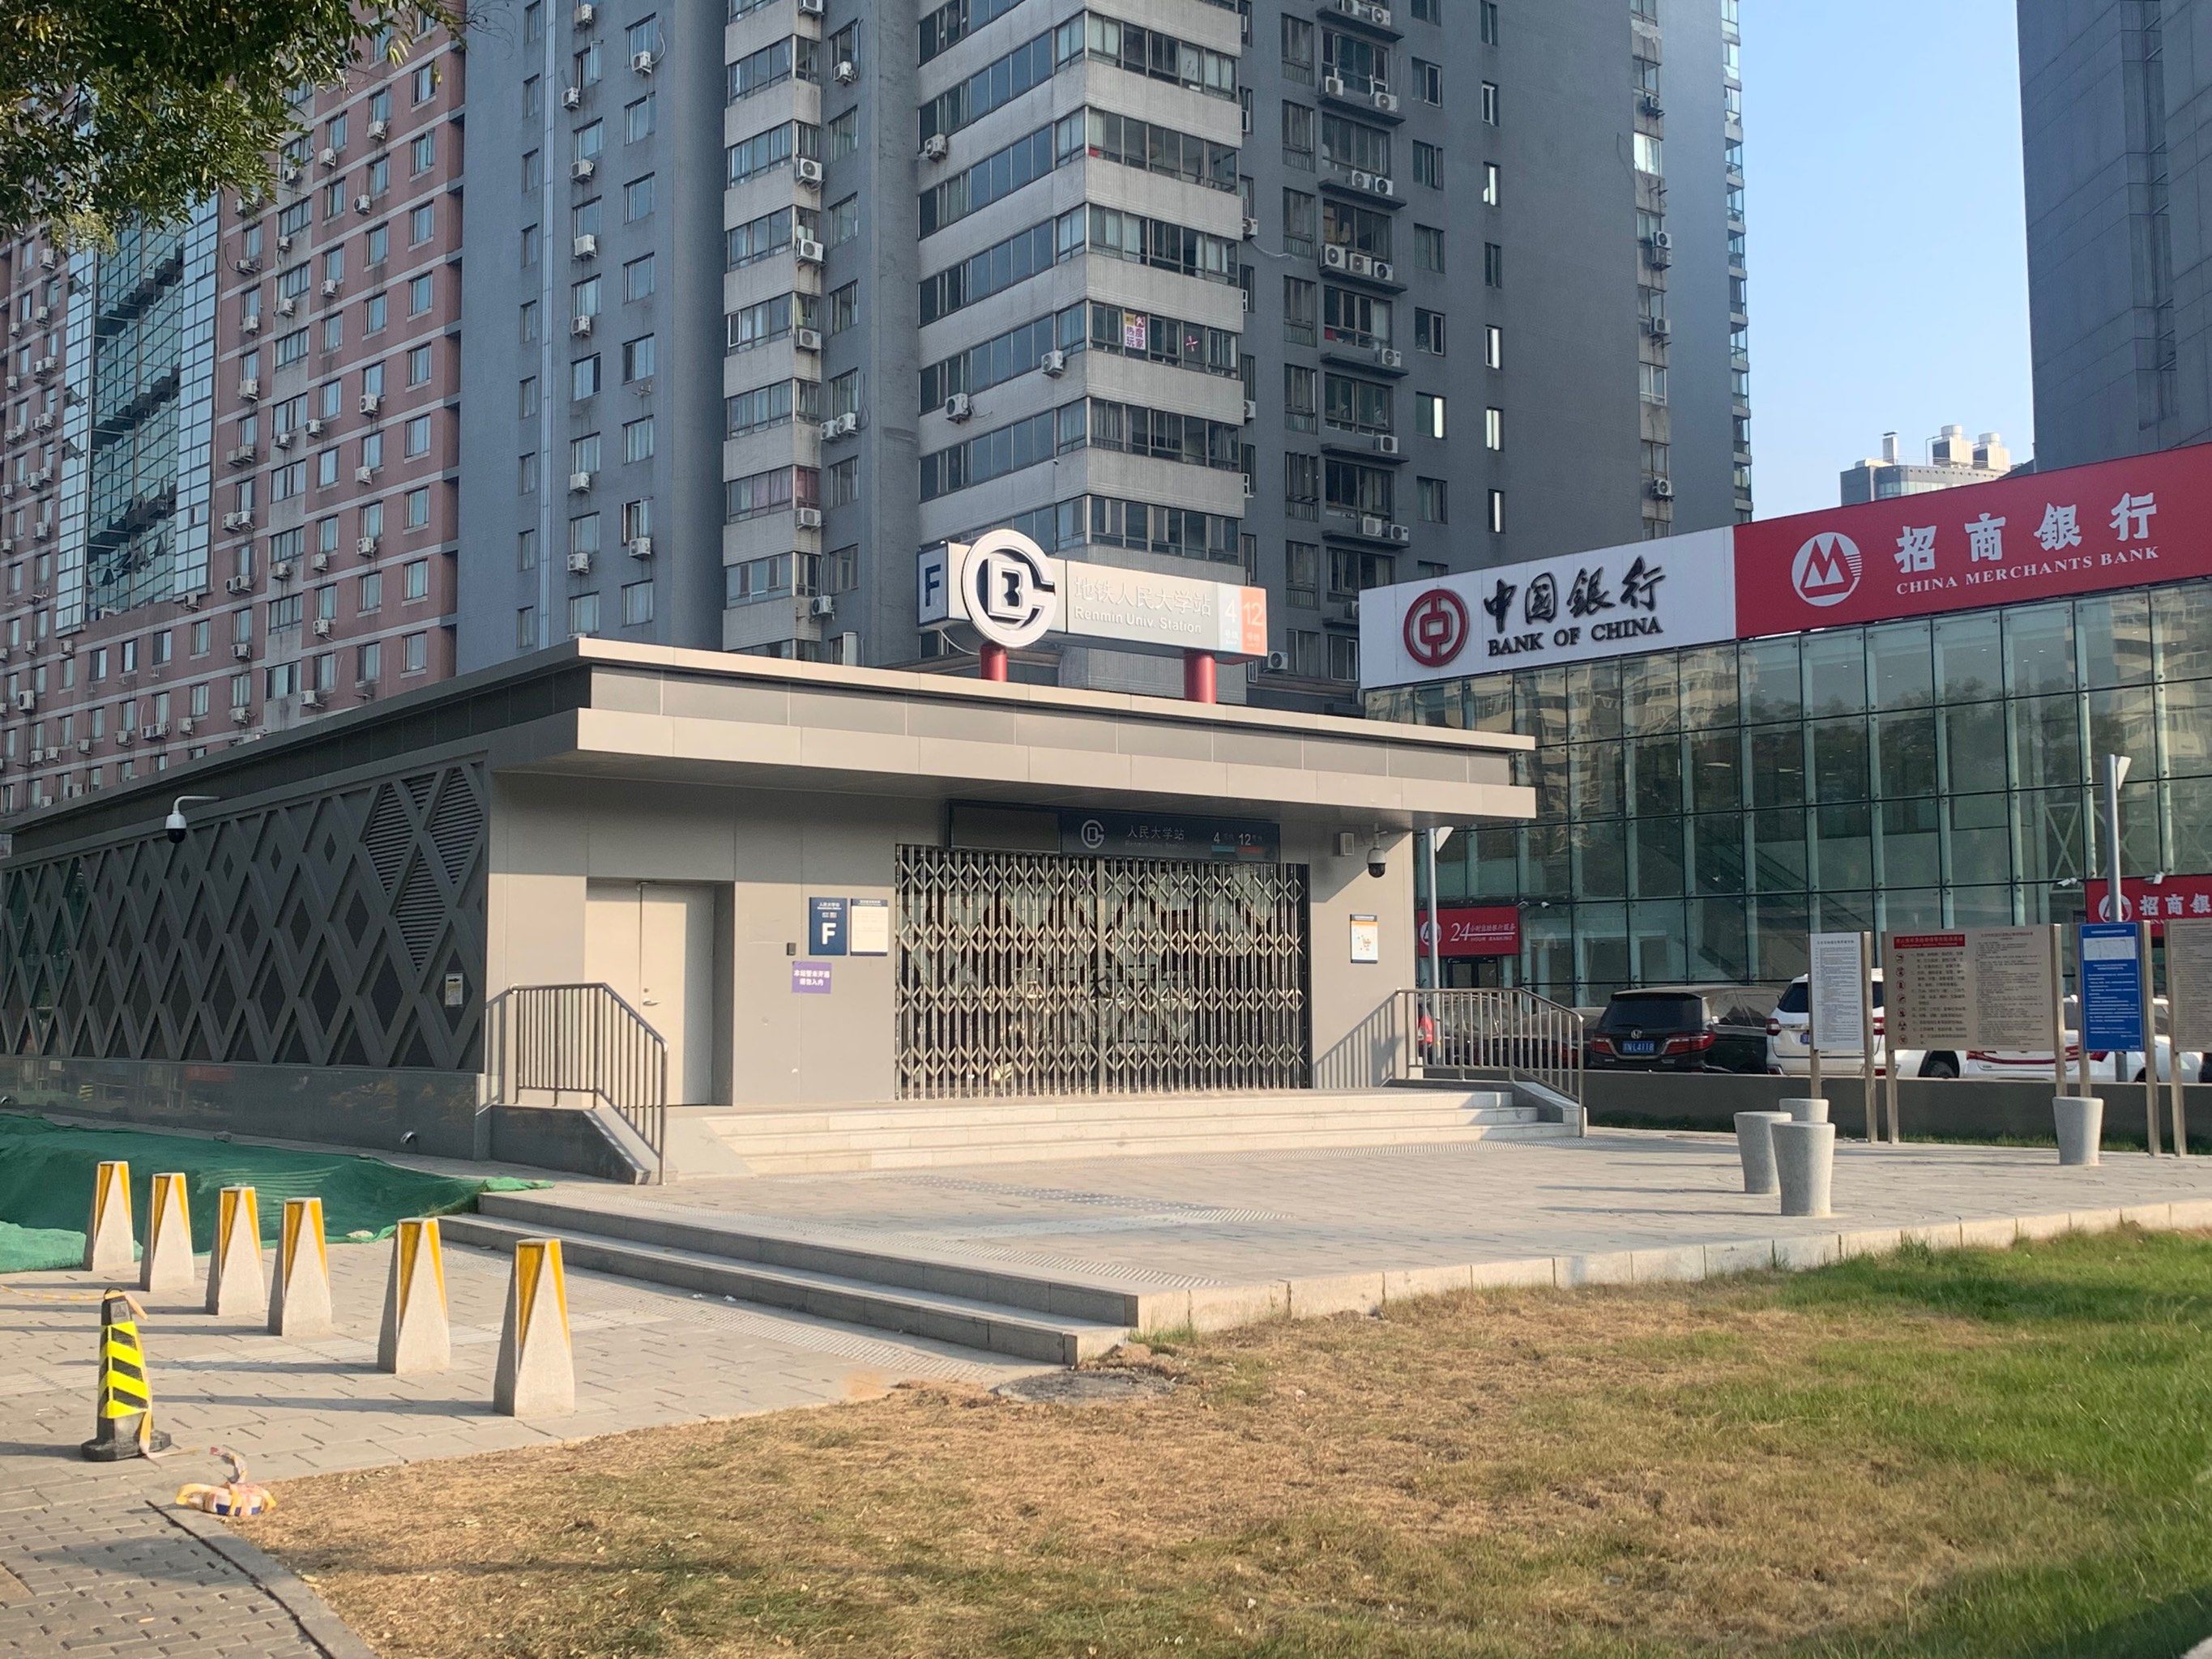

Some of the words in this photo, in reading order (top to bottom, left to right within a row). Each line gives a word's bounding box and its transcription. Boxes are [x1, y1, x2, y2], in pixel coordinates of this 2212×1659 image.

[1896, 576, 1958, 595] CHINA
[1966, 556, 2093, 586] MERCHANTS
[2100, 546, 2159, 566] BANK
[925, 564, 942, 607] F
[1074, 576, 1211, 617] 地铁人民大学站
[1074, 607, 1123, 625] Renmin
[1125, 613, 1155, 629] Univ.
[1159, 616, 1202, 633] Station
[1224, 598, 1237, 623] 4
[1244, 602, 1264, 626] 12
[1488, 633, 1544, 656] BANK
[1553, 627, 1581, 646] OF
[1591, 616, 1663, 642] CHINA
[1127, 825, 1185, 842] 人民大学站
[1213, 831, 1220, 844] 4
[1238, 833, 1252, 846] 12
[822, 922, 836, 945] F
[1450, 922, 1471, 942] 24
